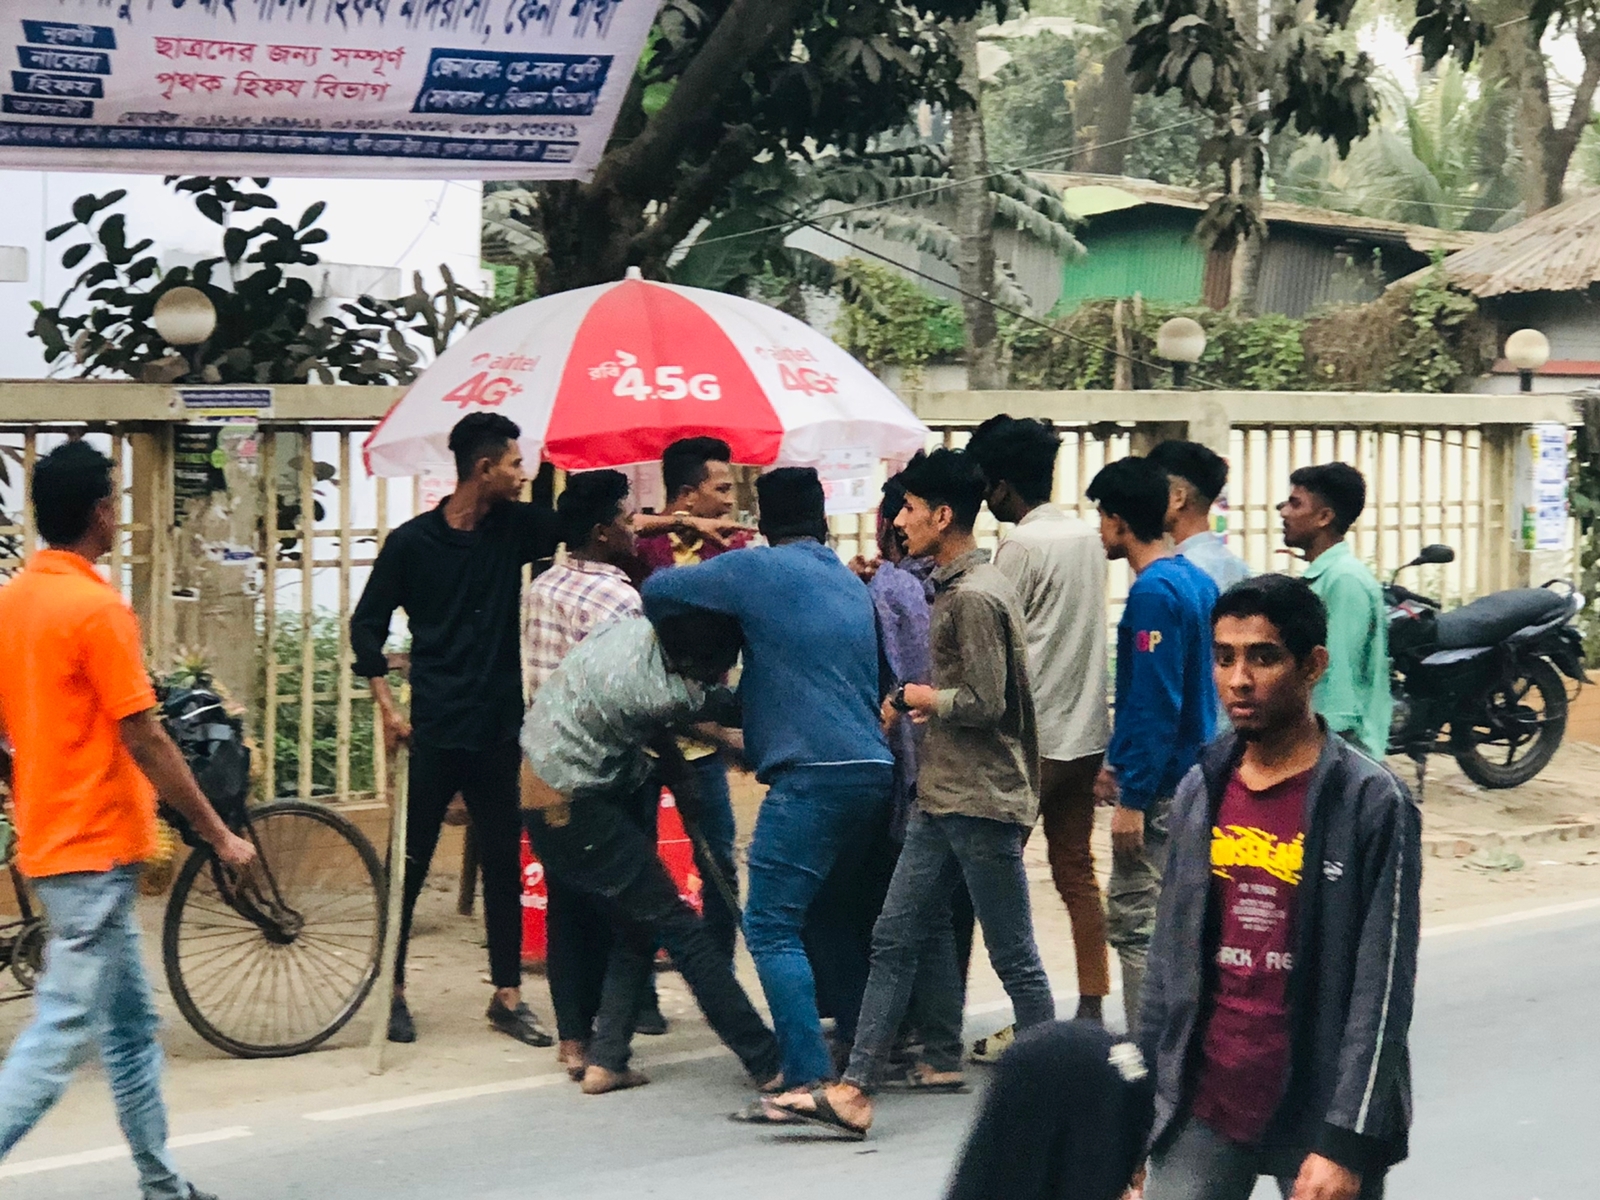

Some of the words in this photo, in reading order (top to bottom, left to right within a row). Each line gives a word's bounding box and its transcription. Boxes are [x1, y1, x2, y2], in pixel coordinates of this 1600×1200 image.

[152, 36, 258, 63] ছাত্রদের
[266, 45, 322, 67] জন্য
[330, 46, 406, 76] সম্পূর্ণ
[155, 72, 227, 100] পৃথক
[315, 74, 391, 101] বিভাগ
[612, 365, 722, 401] 4.5G
